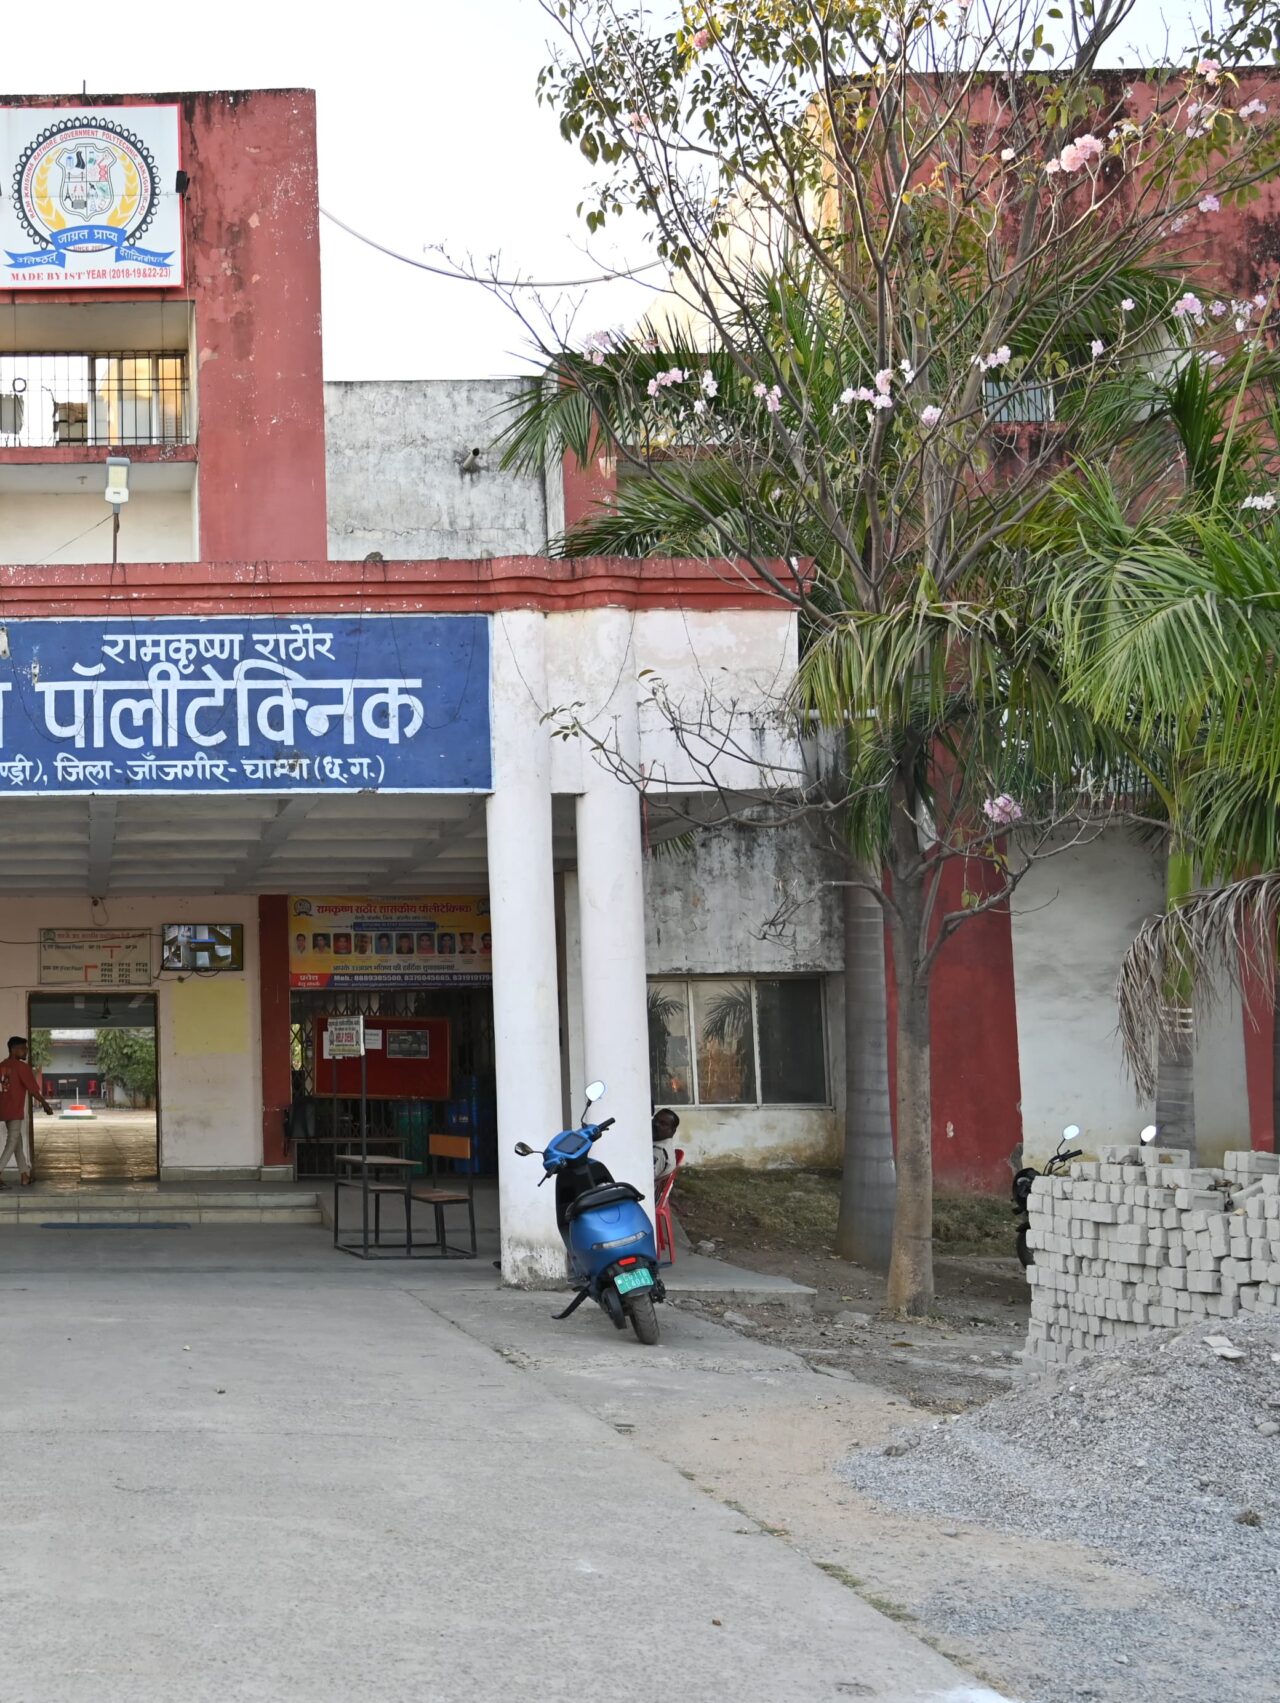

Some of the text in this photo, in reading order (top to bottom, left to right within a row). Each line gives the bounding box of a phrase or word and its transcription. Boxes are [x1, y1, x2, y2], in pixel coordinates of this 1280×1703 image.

[24, 161, 34, 198] KRISHNA
[33, 138, 58, 162] RATHORE
[59, 129, 98, 142] GOVERNMENT
[101, 131, 138, 161] POLYTECHNIC
[11, 272, 44, 281] MADE
[46, 272, 61, 281] BY
[86, 269, 107, 279] YEAR
[101, 633, 244, 674] रामकृष्ण
[34, 658, 424, 749] पॉलीटेक्निक
